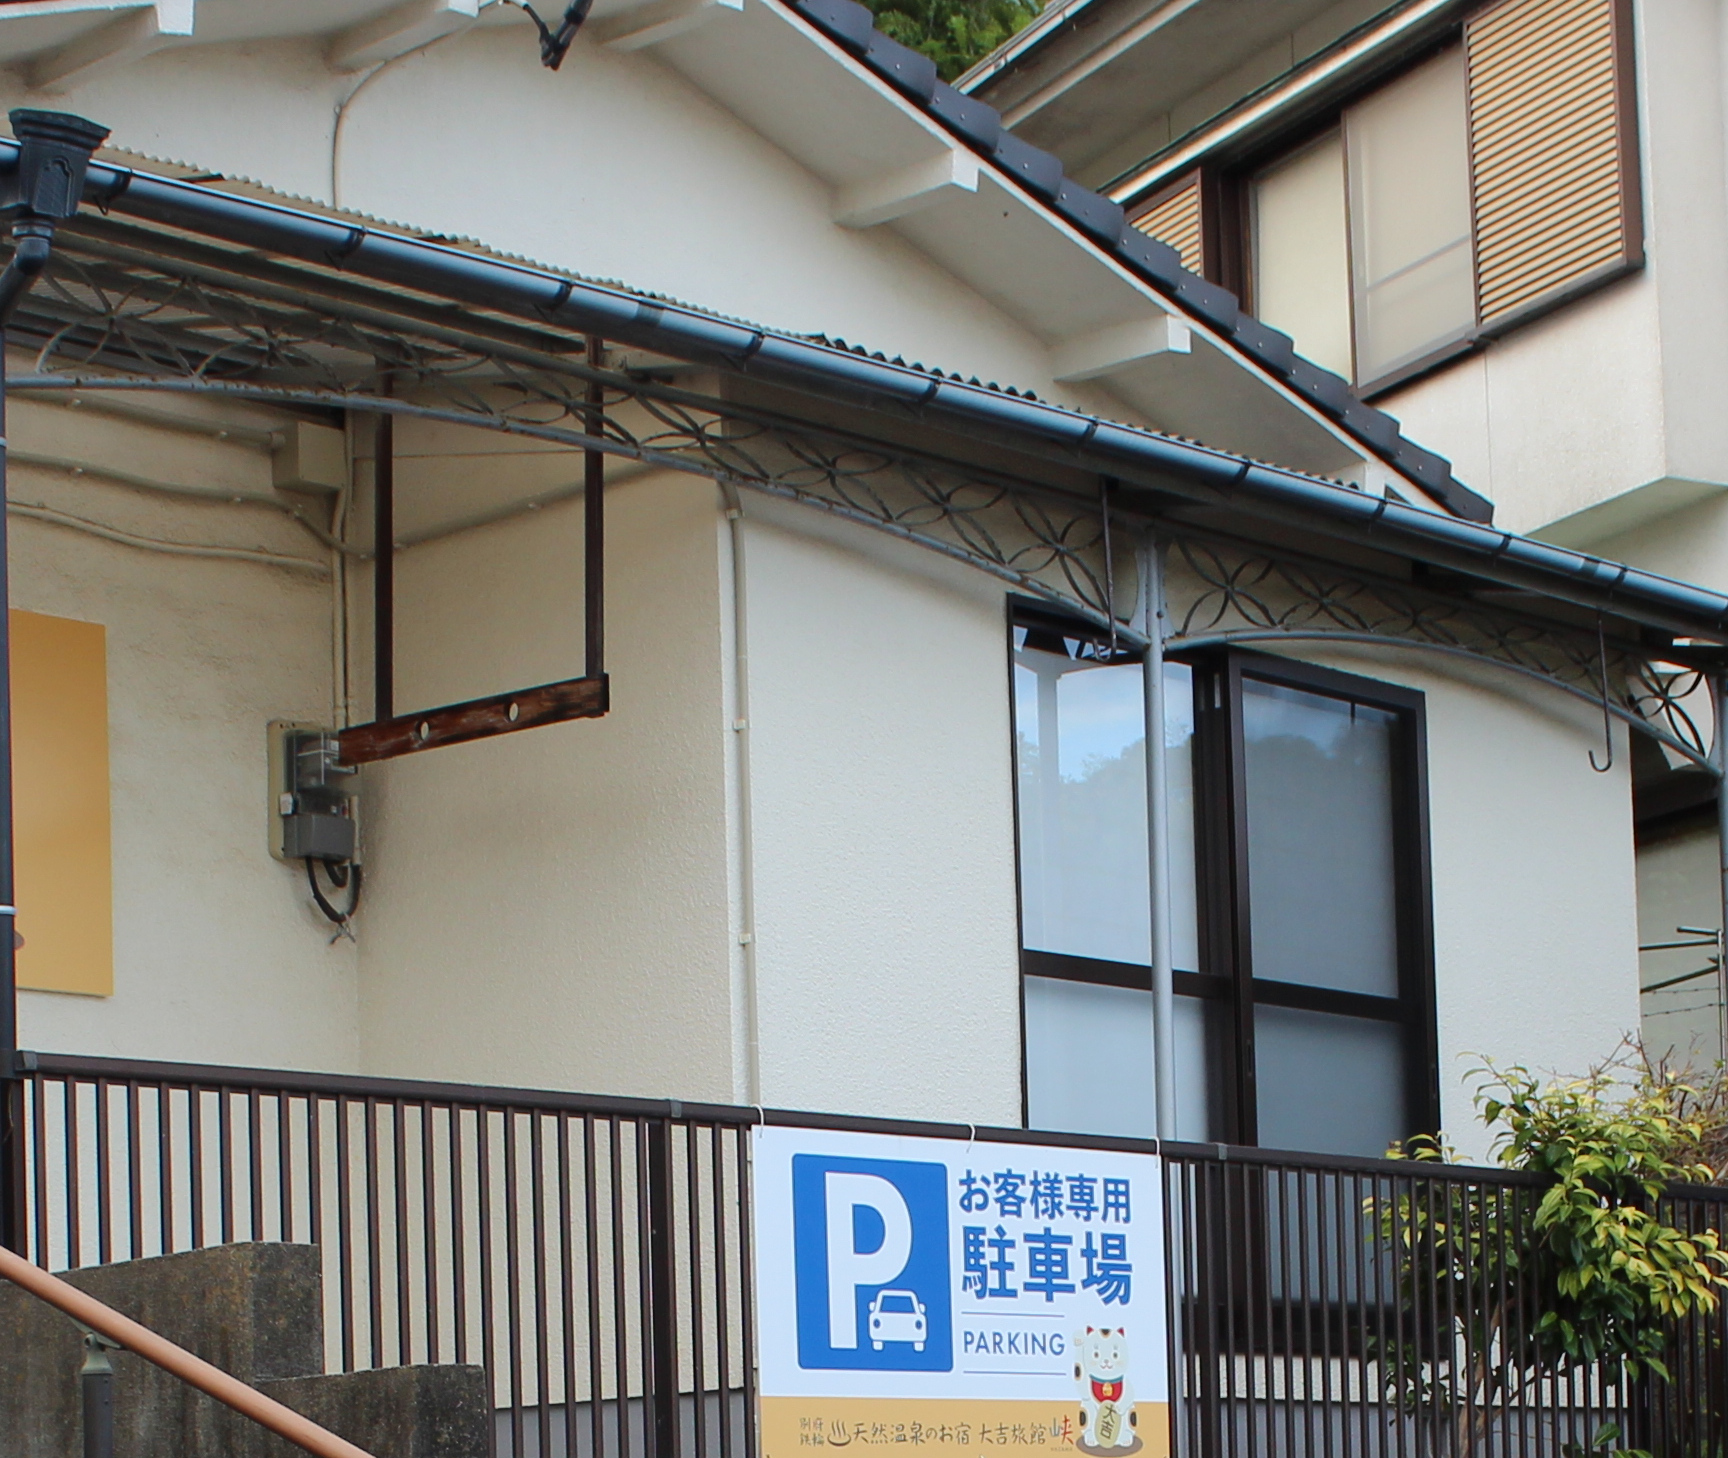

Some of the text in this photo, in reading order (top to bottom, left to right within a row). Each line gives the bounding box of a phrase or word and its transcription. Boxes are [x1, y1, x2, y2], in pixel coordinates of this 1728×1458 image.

[958, 1168, 1132, 1224] お客様専用
[824, 1170, 913, 1350] P
[962, 1224, 1133, 1306] 駐車場
[962, 1330, 1066, 1356] PARKING
[1100, 1403, 1118, 1440] 大吉
